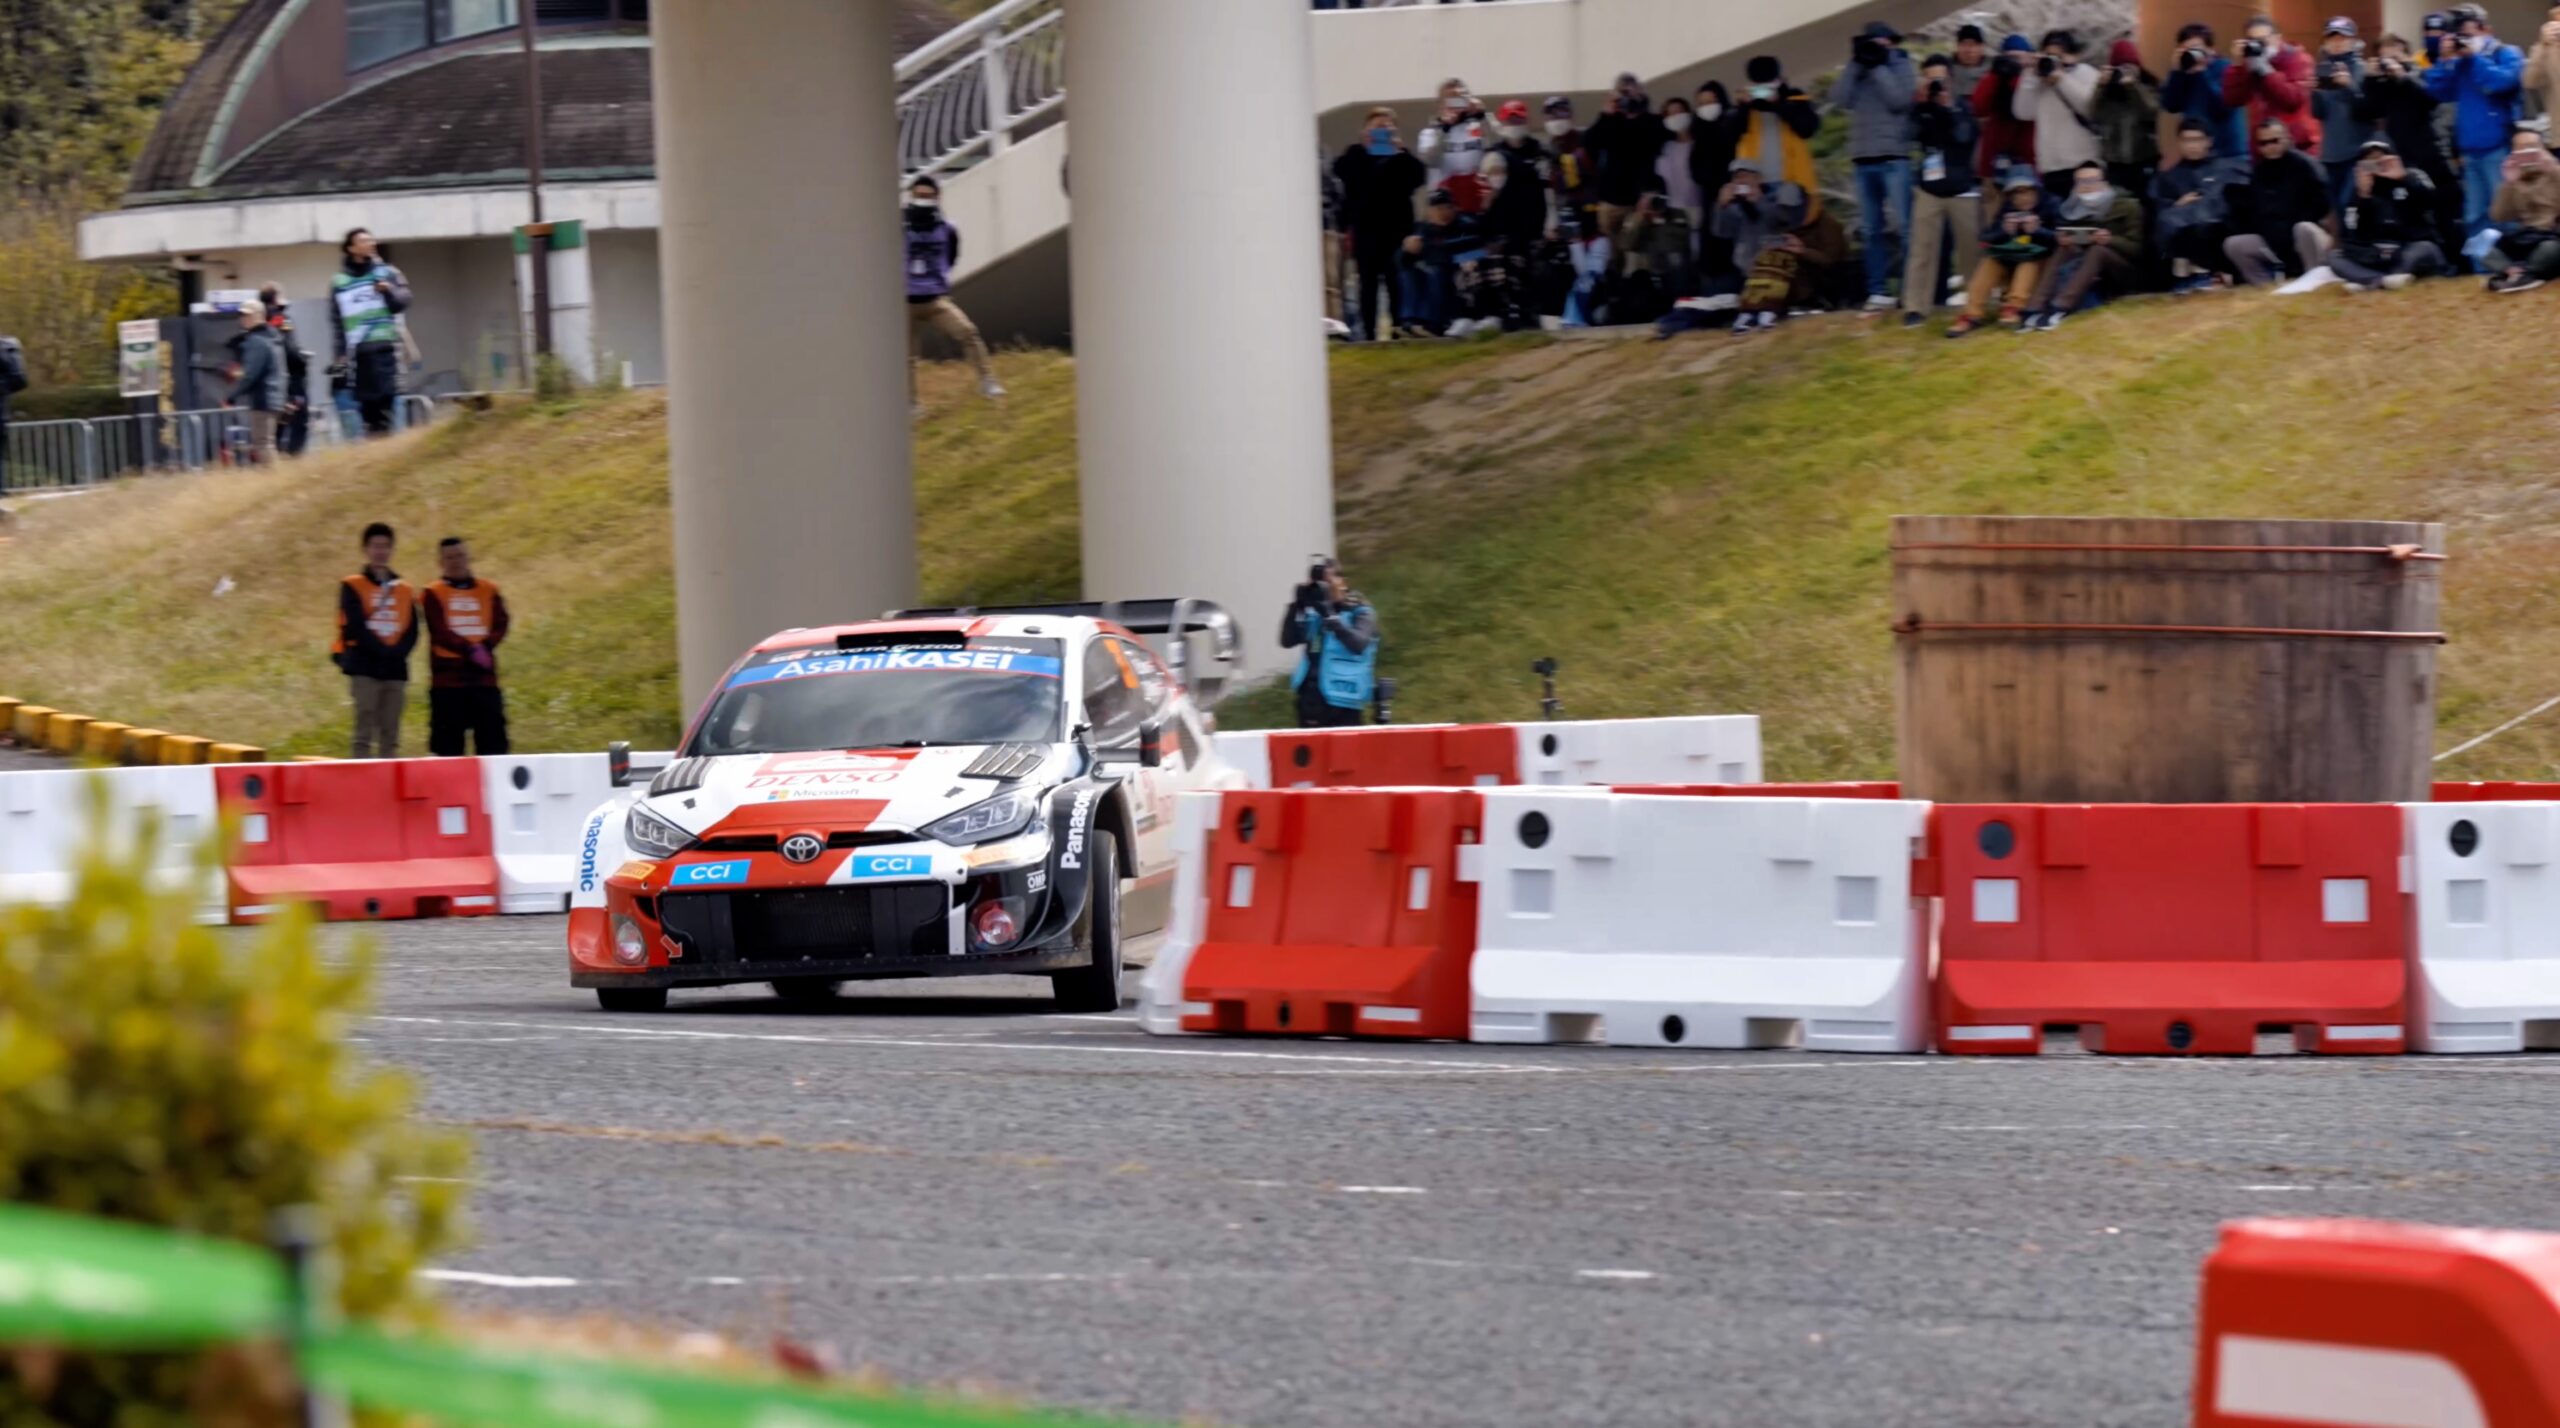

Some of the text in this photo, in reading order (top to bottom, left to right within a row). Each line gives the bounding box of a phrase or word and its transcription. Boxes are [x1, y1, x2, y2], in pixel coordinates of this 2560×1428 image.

[745, 772, 901, 789] DENSO
[793, 788, 859, 798] Microsoft
[1061, 789, 1096, 869] Panasoni
[690, 865, 730, 880] CCI
[870, 857, 912, 872] CCI
[1027, 872, 1047, 889] OMP
